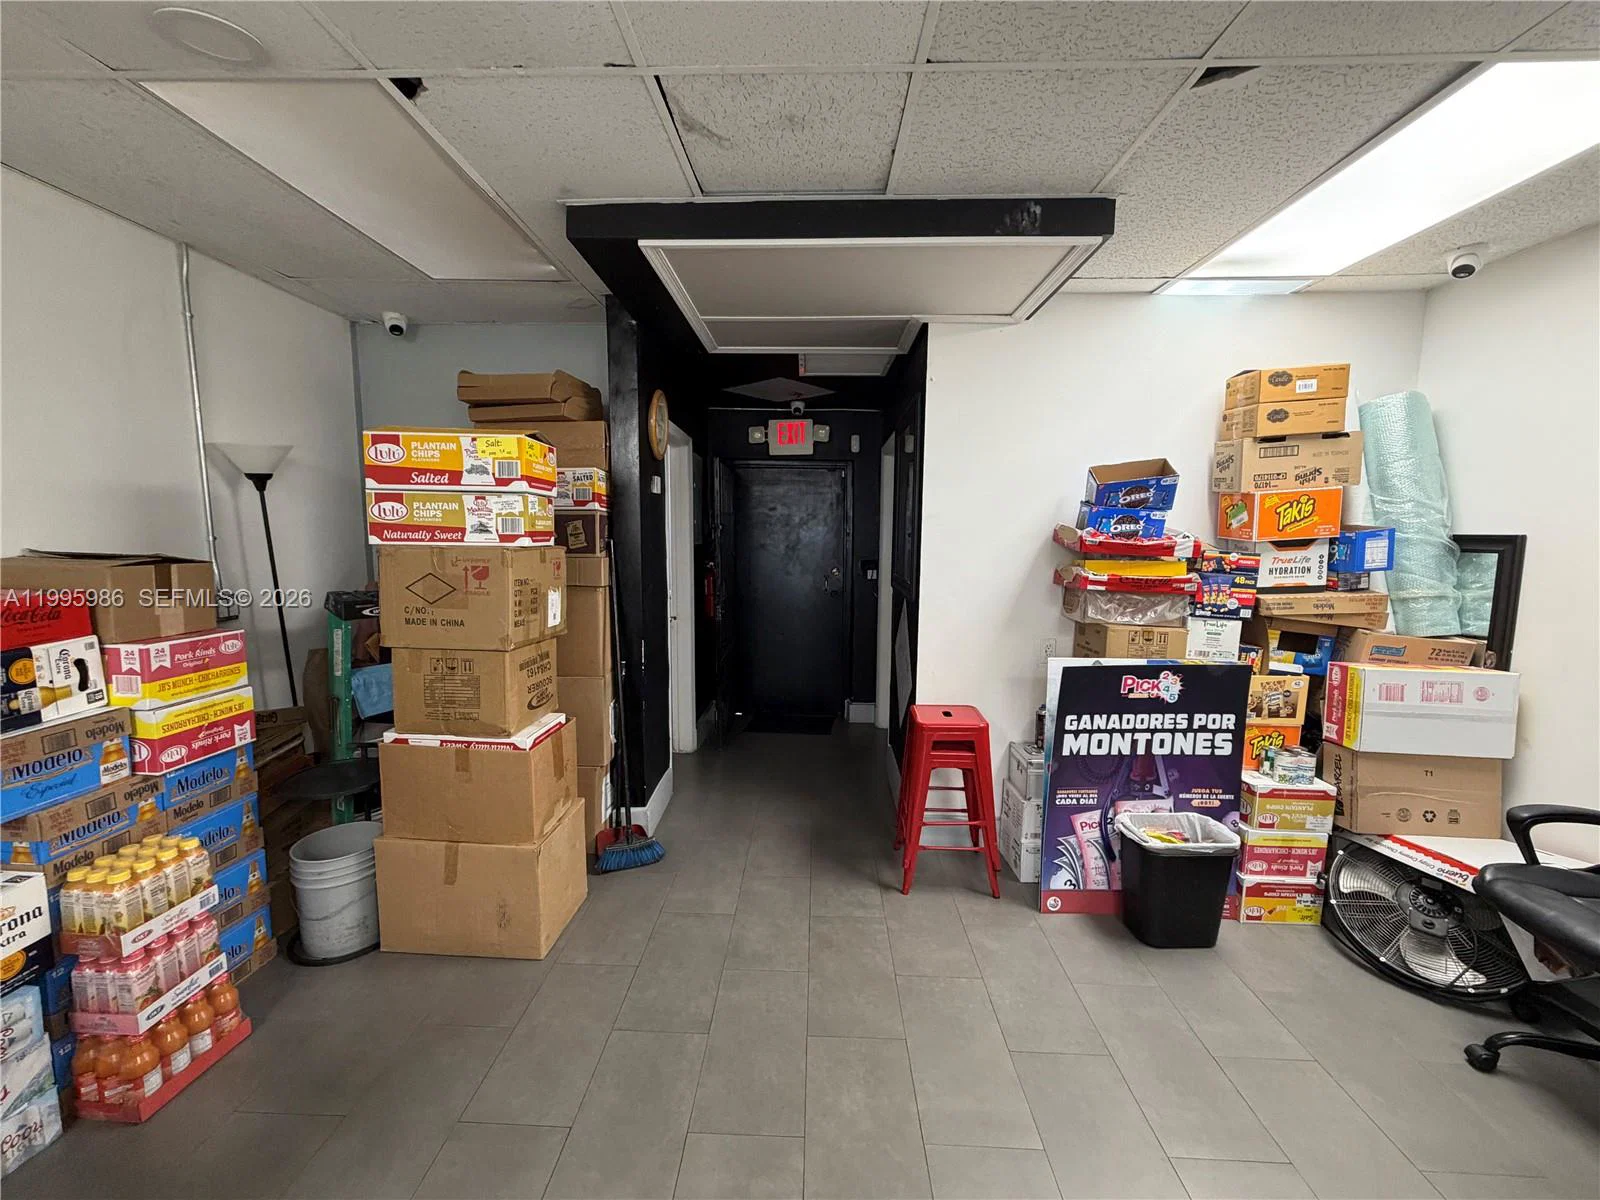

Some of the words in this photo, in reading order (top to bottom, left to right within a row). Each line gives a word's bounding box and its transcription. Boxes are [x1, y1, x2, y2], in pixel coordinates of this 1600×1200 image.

[778, 422, 808, 445] EXIT
[411, 442, 456, 450] PLANTAIN
[410, 472, 449, 484] Salted
[1120, 492, 1153, 503] OREO
[413, 502, 458, 510] PLANTAIN
[1276, 495, 1315, 530] Takis
[1110, 524, 1142, 532] OREO
[383, 530, 431, 541] Naturally
[434, 530, 462, 540] Sweet
[1272, 556, 1311, 565] TrueLife
[1268, 566, 1312, 576] HYDRATION
[440, 618, 465, 627] CHINA
[174, 652, 194, 662] Pork
[196, 646, 216, 658] Rinds
[1430, 648, 1442, 656] 72
[172, 677, 194, 690] MUNCH
[198, 666, 242, 683] CHICHARRONES
[214, 705, 233, 718] MUNCH
[161, 712, 210, 734] CHICHARRONES
[1064, 714, 1188, 730] GANADORES
[1193, 714, 1236, 730] POR
[85, 720, 125, 740] Modelo
[211, 731, 232, 742] Pork
[192, 736, 210, 750] Rinds
[1062, 732, 1232, 756] MONTONES
[176, 766, 224, 794] Modelo
[123, 781, 160, 801] Modelo
[172, 800, 204, 820] Modelo
[1080, 820, 1102, 832] PIC
[53, 850, 94, 876] Modelo
[1437, 867, 1469, 883] bueno
[1064, 879, 1076, 889] 3
[0, 906, 42, 936] rona
